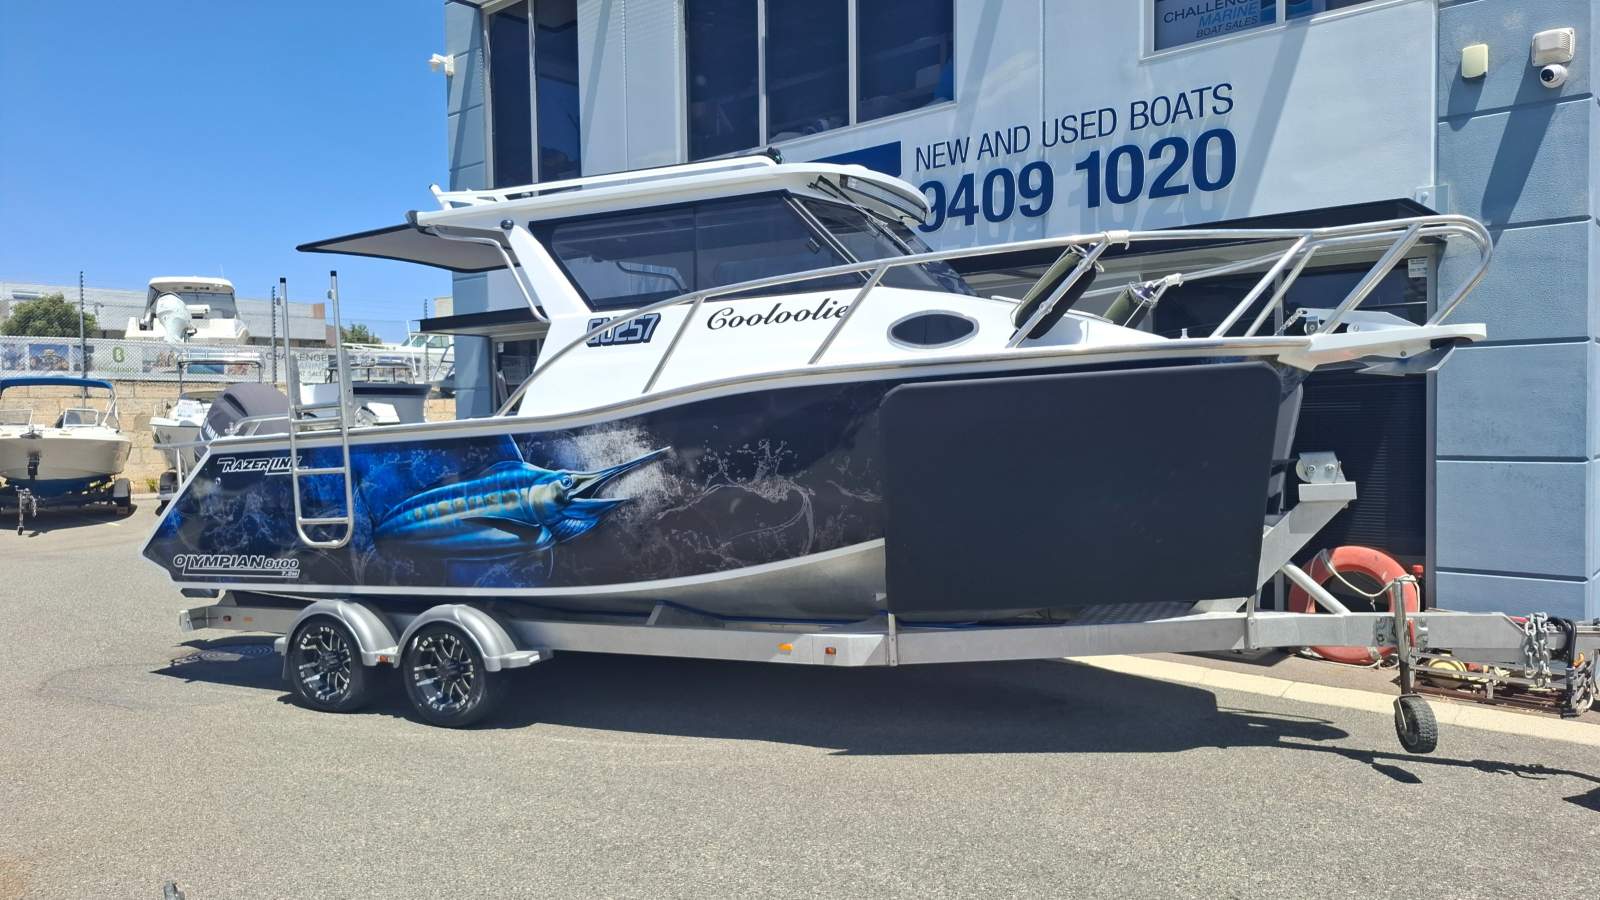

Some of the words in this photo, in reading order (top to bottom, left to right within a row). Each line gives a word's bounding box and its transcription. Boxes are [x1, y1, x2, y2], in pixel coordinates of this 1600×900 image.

[1163, 0, 1258, 24] CHALLEN
[1199, 2, 1259, 28] MARINE
[1196, 24, 1223, 38] BOAT
[1225, 15, 1258, 31] SALES
[916, 137, 970, 172] NEW
[977, 126, 1031, 160] AND
[1042, 107, 1117, 148] USED
[1130, 83, 1234, 131] BOATS
[918, 161, 1054, 233] 9409
[1075, 128, 1237, 209] 1020
[707, 297, 849, 330] Cooloolie
[173, 554, 265, 572] OLYMPIAN
[264, 558, 299, 569] 8100
